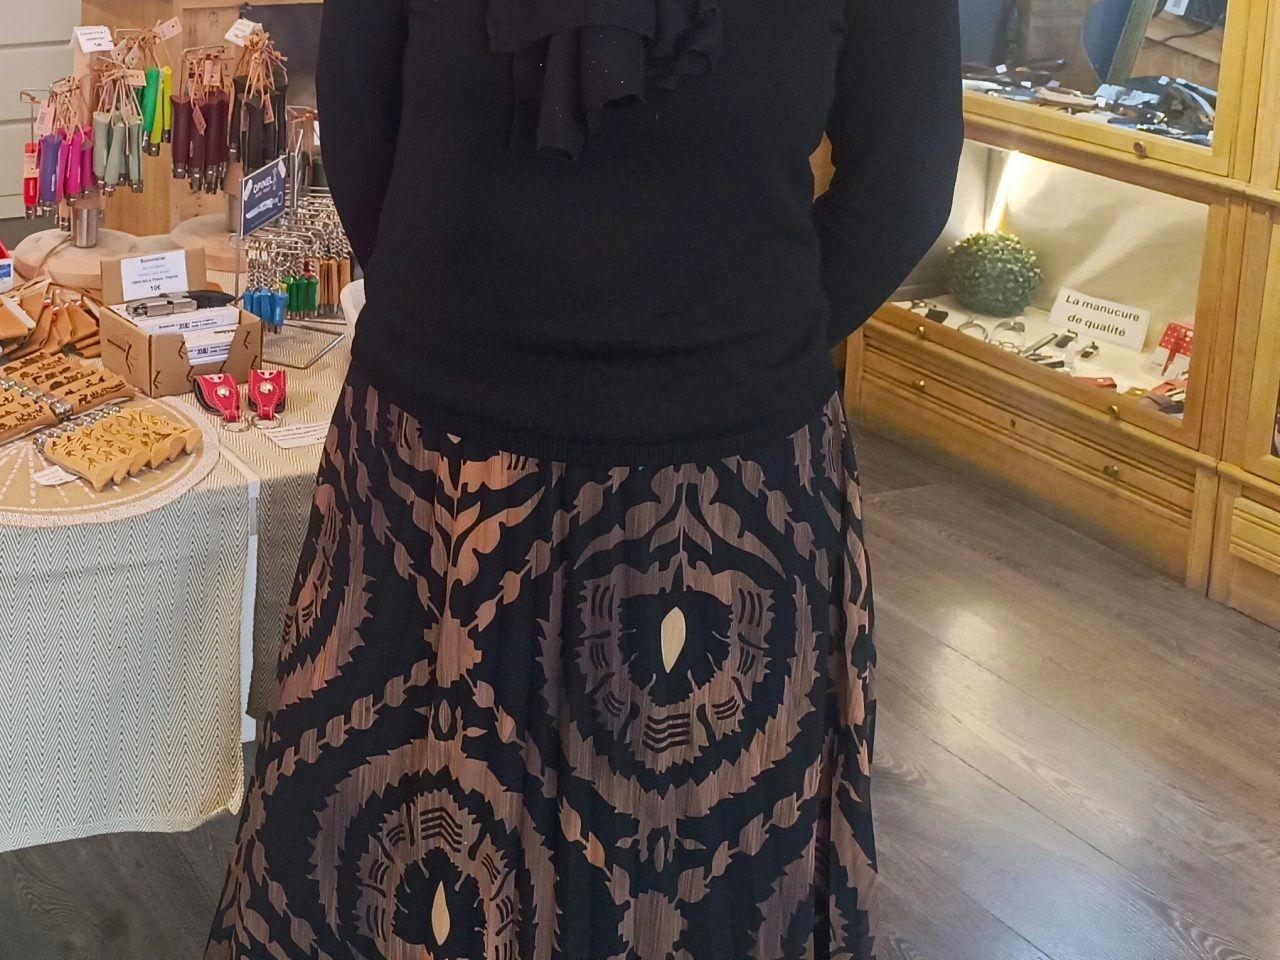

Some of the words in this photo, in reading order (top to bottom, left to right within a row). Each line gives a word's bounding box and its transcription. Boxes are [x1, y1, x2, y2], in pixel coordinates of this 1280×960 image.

[253, 176, 273, 194] OPINEL
[1065, 294, 1080, 306] La
[1081, 301, 1140, 322] manucure
[1067, 313, 1082, 325] de
[1084, 319, 1126, 337] qualité
